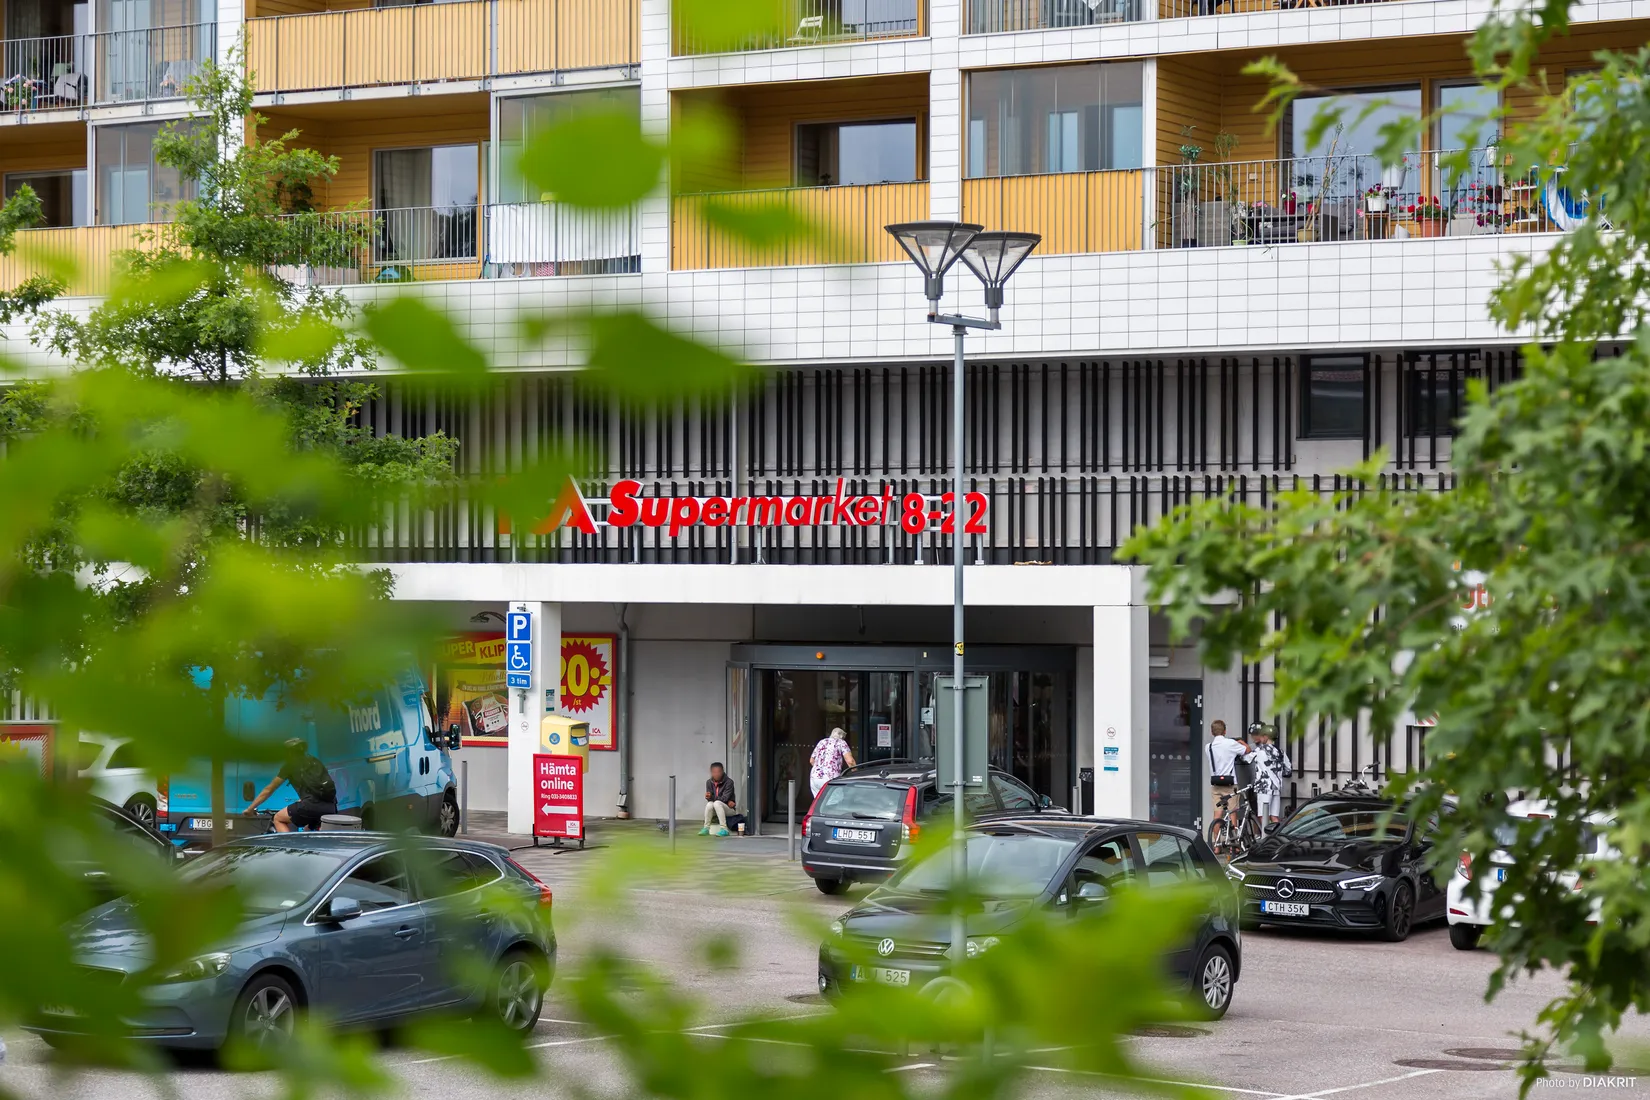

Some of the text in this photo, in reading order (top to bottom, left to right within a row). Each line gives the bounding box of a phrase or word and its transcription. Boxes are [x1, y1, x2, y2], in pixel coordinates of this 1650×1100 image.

[607, 477, 892, 537] Supermarket
[902, 491, 988, 535] 8-22
[513, 615, 527, 639] P
[480, 643, 506, 659] KLIP
[510, 677, 528, 685] 3 tim
[540, 763, 577, 776] Hämta
[540, 777, 575, 790] online
[196, 819, 212, 828] YBG
[857, 831, 874, 840] 551
[1268, 902, 1305, 914] CTH 35K
[886, 969, 907, 984] 525
